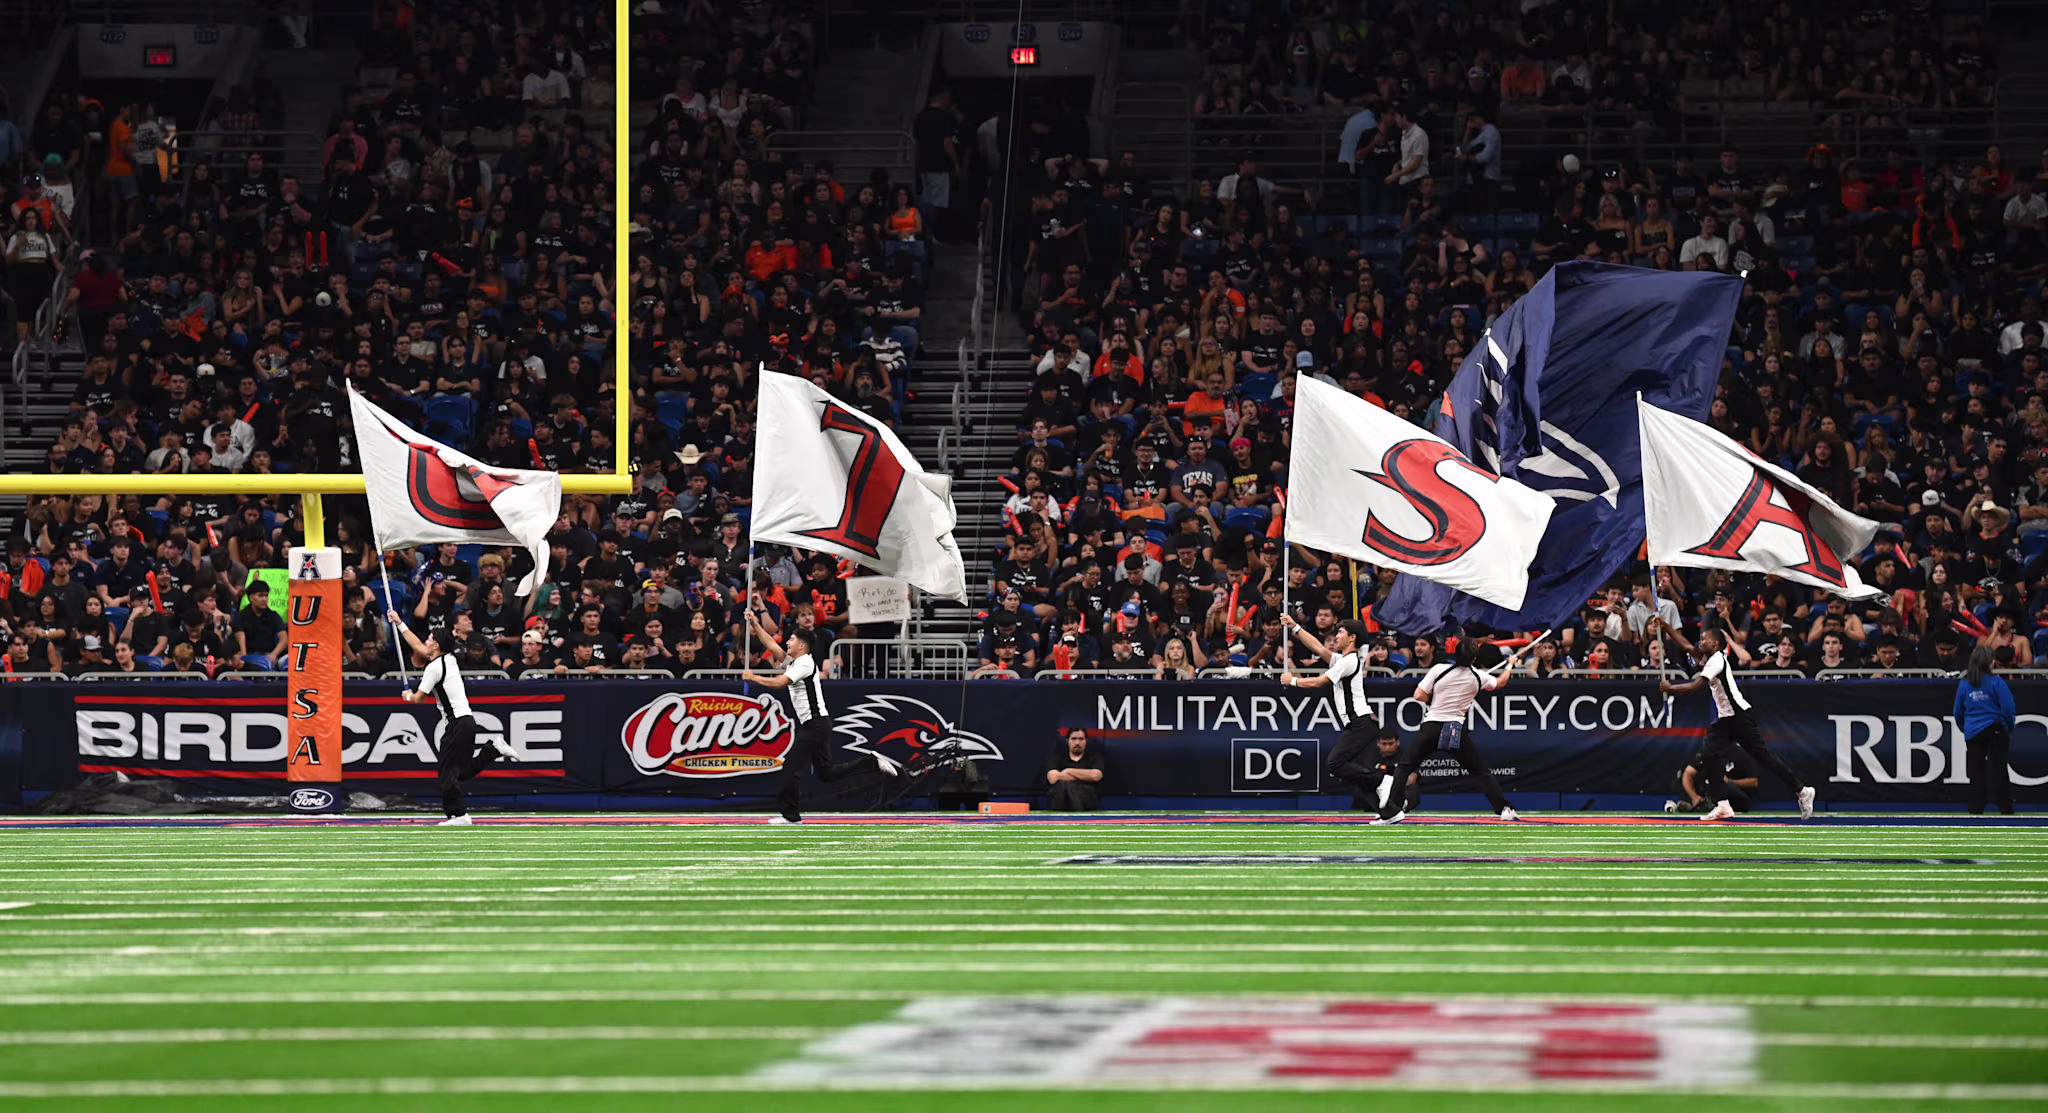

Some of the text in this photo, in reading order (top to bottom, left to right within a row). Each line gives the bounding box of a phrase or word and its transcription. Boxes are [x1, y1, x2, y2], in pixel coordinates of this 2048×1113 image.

[1182, 471, 1213, 489] TEXAS
[1351, 437, 1500, 566] S
[1683, 464, 1852, 592] A
[688, 699, 744, 717] Raising
[1097, 694, 1675, 732] MILITARYATONEY.COM
[632, 694, 789, 770] Cane's
[685, 758, 775, 768] CHICKEN FINGERS
[1244, 747, 1303, 781] DC
[293, 790, 326, 807] Ford
